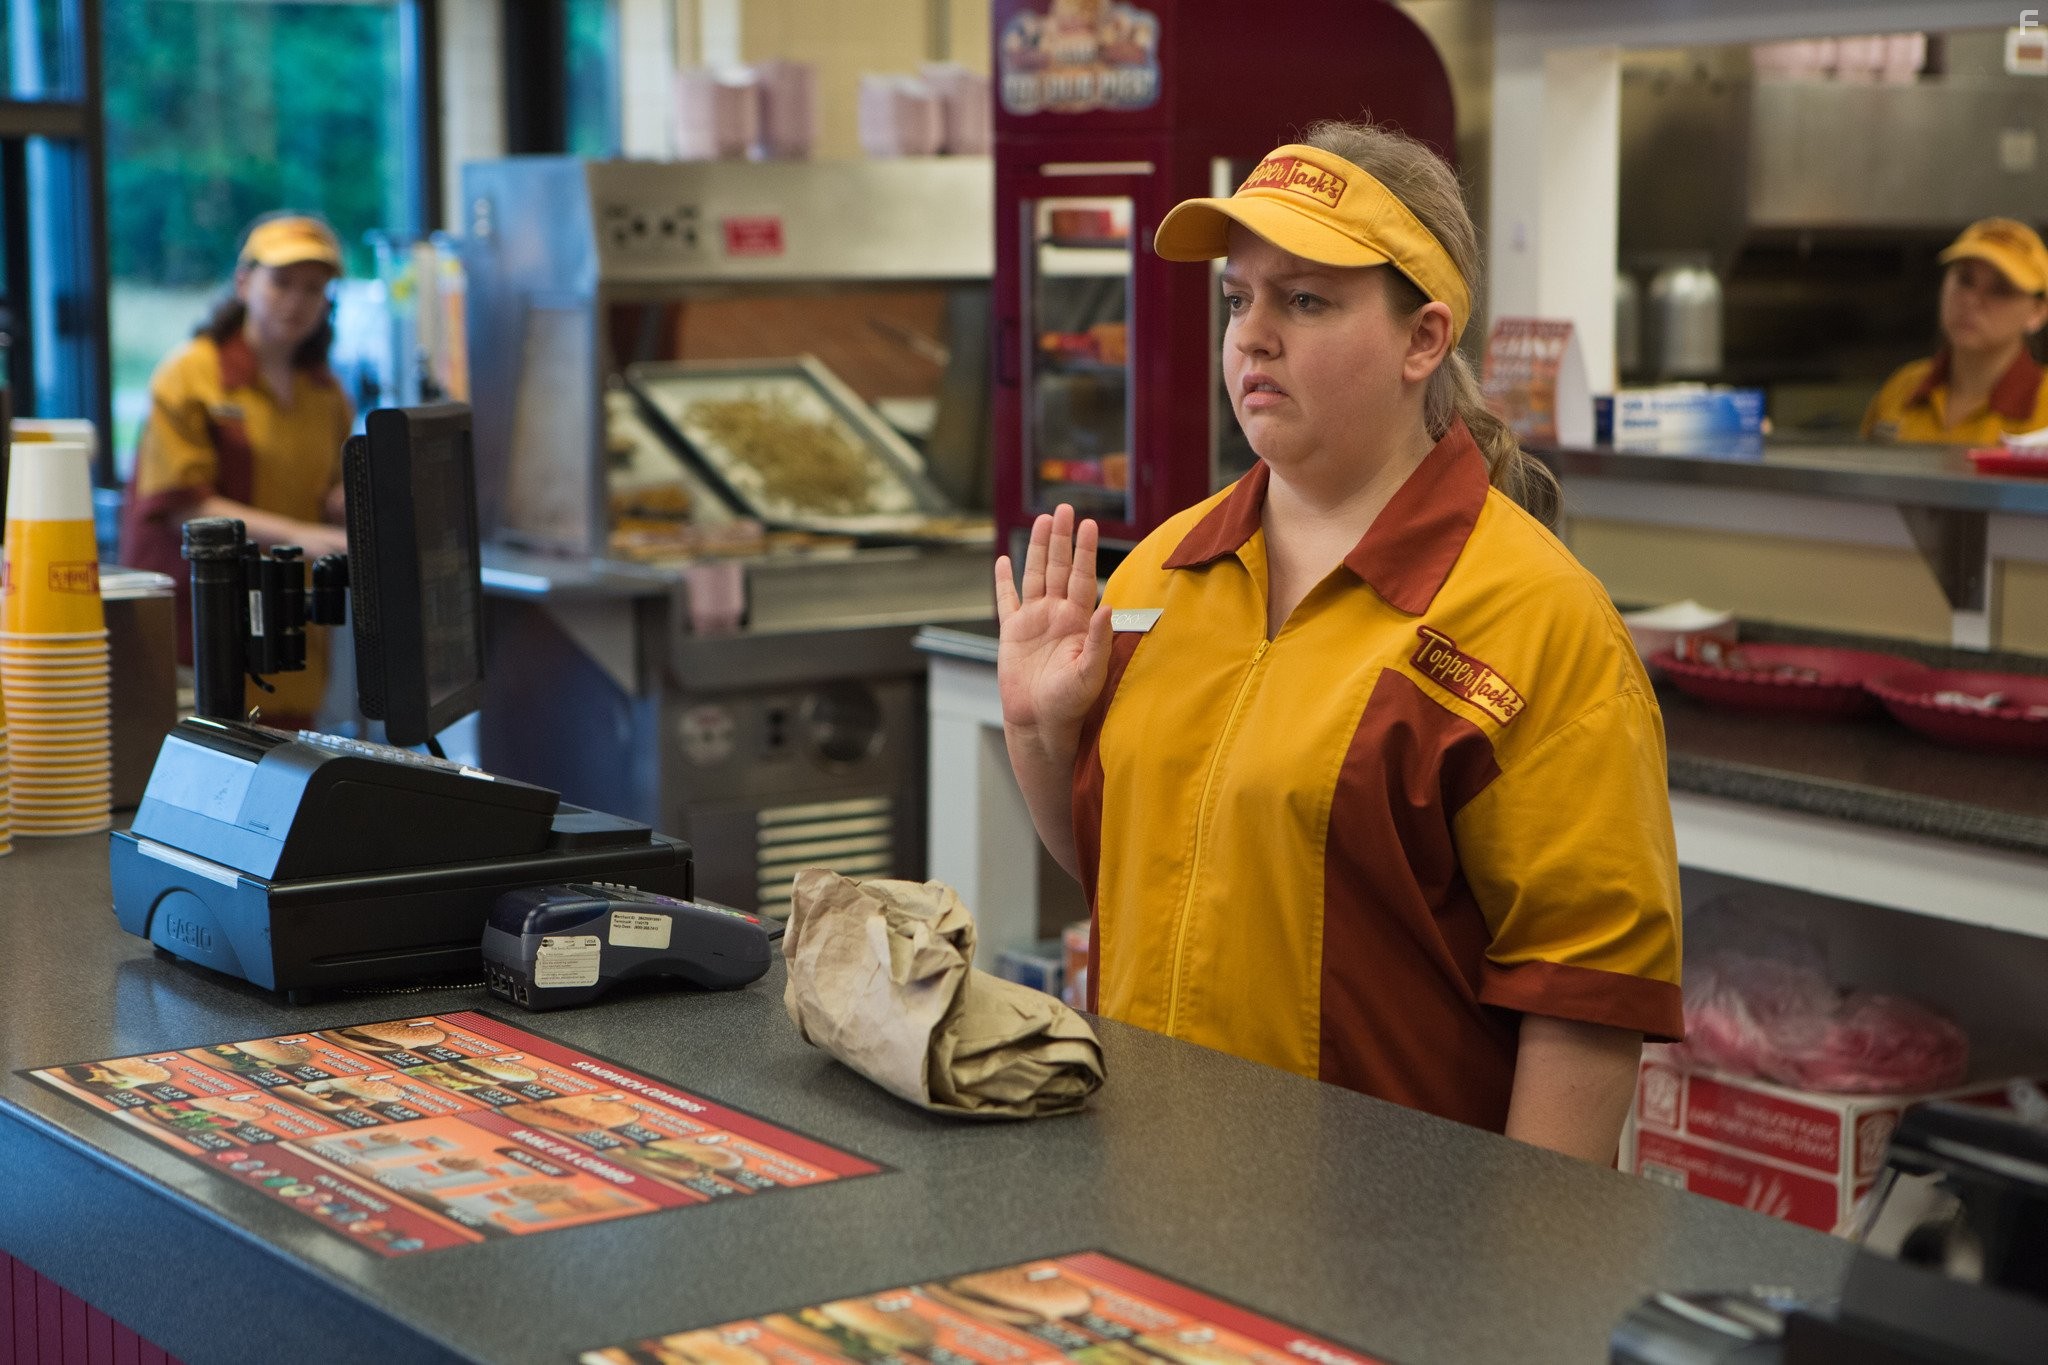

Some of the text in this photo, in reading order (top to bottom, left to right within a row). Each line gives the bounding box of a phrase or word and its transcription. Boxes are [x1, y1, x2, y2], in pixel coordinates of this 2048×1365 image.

[166, 914, 214, 952] CASIO
[571, 1062, 648, 1089] SANDWICH
[640, 1089, 706, 1112] COMBOS
[511, 1131, 555, 1148] MAKE
[573, 1159, 635, 1182] COMBO
